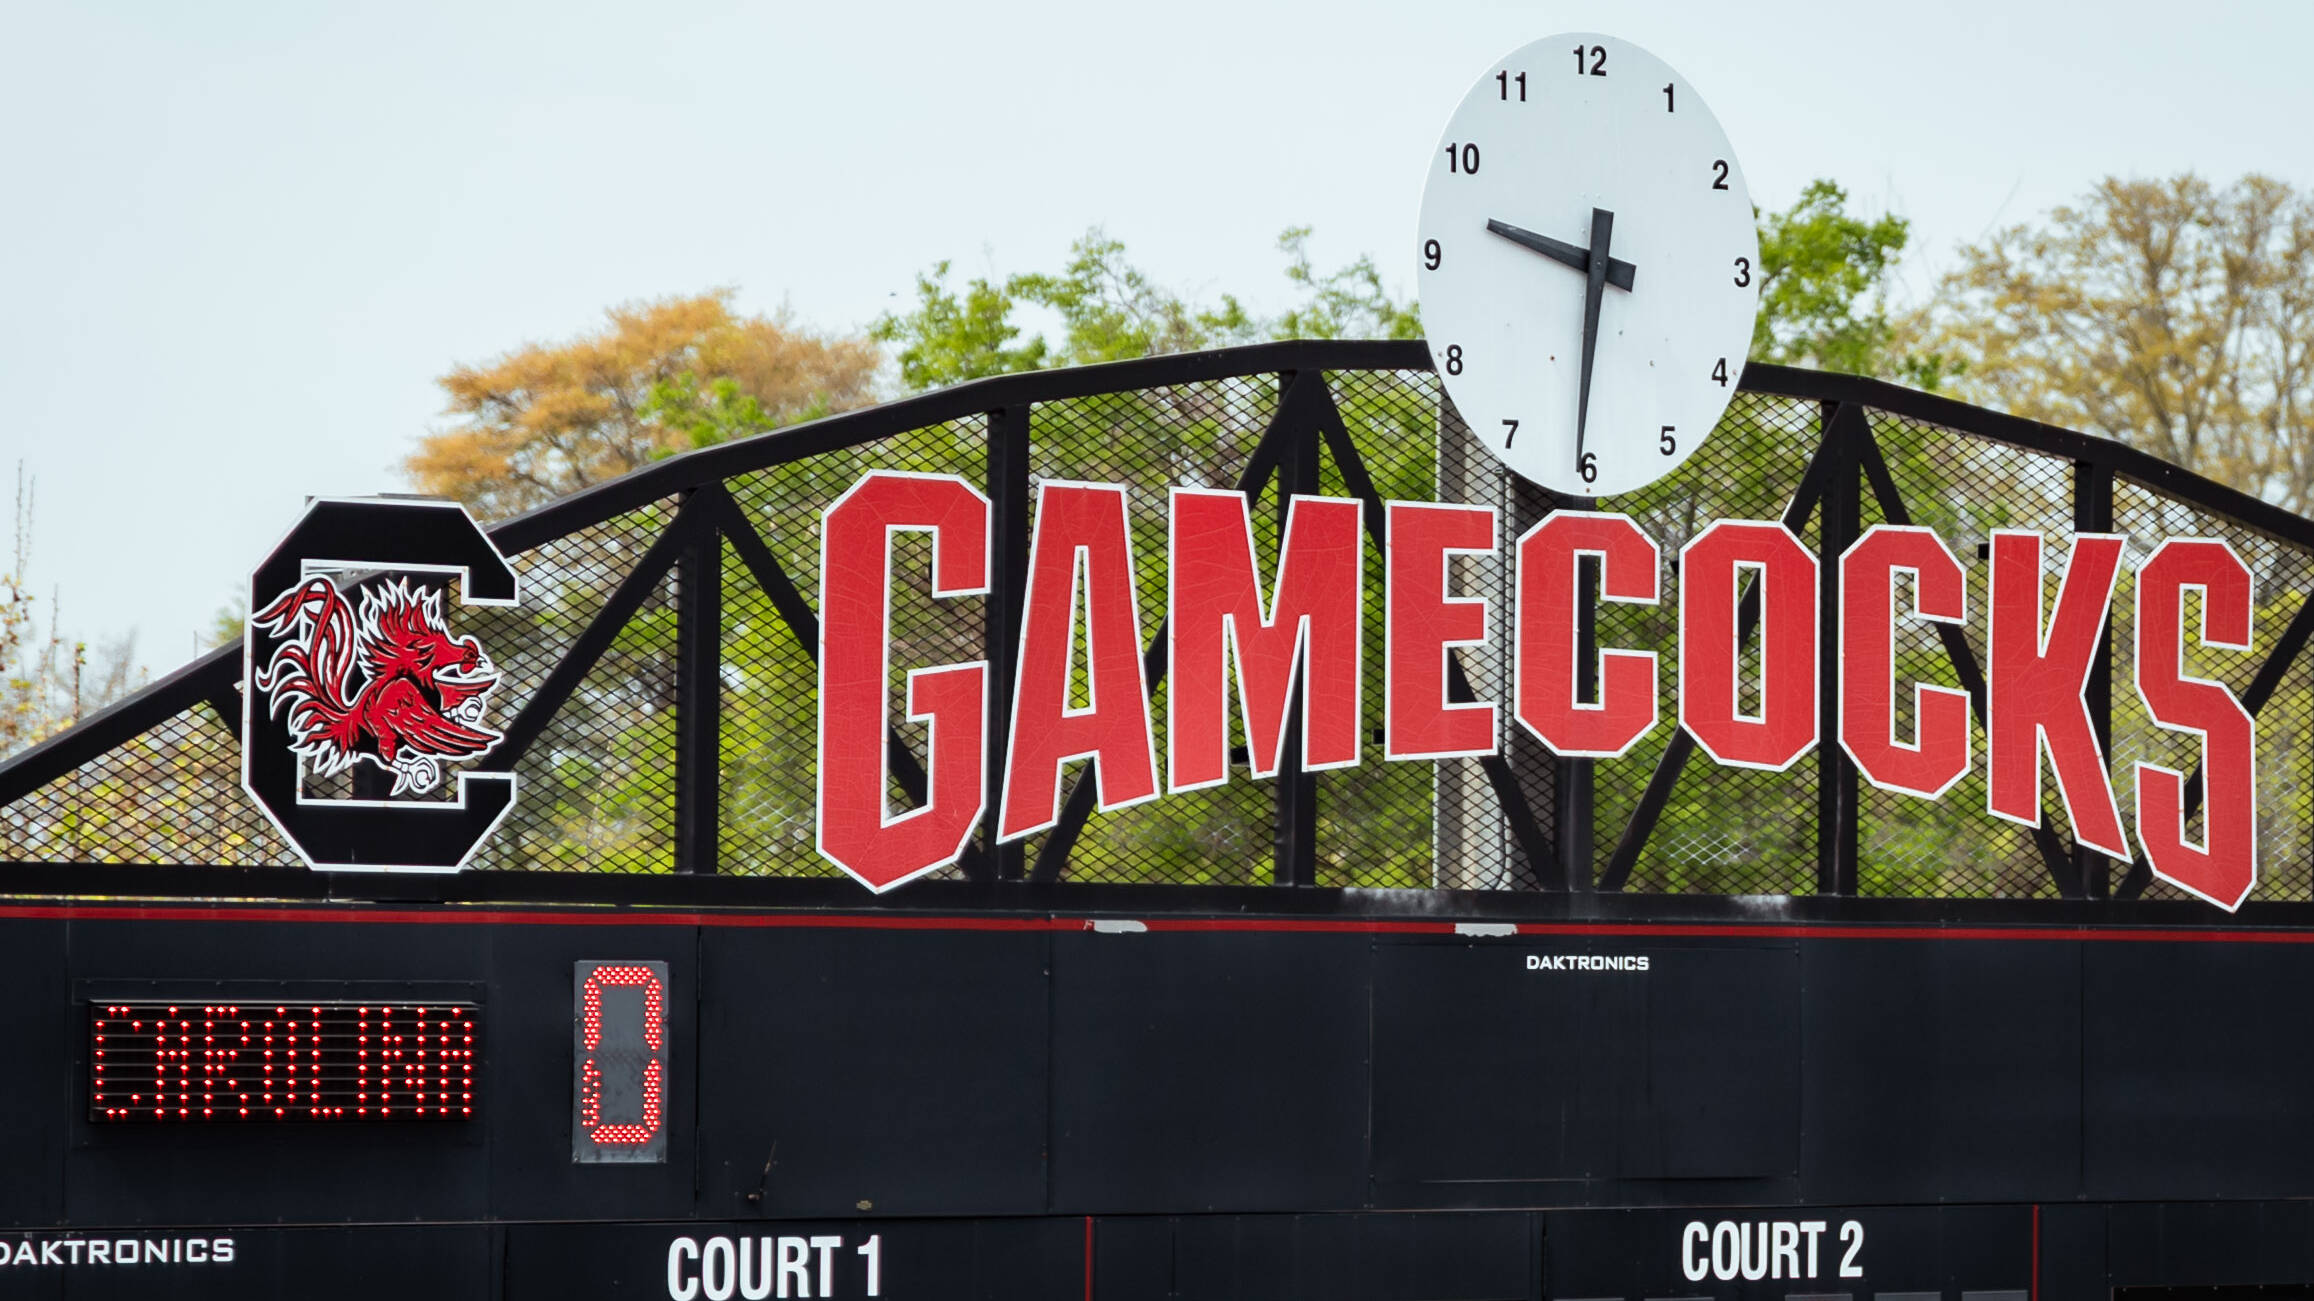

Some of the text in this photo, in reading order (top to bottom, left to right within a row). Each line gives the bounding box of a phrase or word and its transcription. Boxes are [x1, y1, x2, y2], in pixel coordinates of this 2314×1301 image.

[1573, 44, 1607, 77] 12
[1495, 70, 1527, 102] 11
[1662, 82, 1675, 113] 1
[1445, 142, 1480, 175] 10
[1712, 159, 1729, 191] 2
[1424, 239, 1442, 271] 9
[1734, 257, 1751, 288] 3
[1445, 344, 1464, 376] 8
[1711, 357, 1729, 388] 4
[1502, 419, 1519, 450] 7
[1659, 425, 1677, 456] 5
[1580, 452, 1598, 484] 6
[816, 470, 2258, 913] GAMECOCKS
[1526, 955, 1650, 971] DAKTRONICS
[93, 1005, 474, 1118] CAROLINA
[581, 965, 662, 1145] 0
[1682, 1220, 1864, 1282] COURT 2
[667, 1234, 880, 1301] COURT 1
